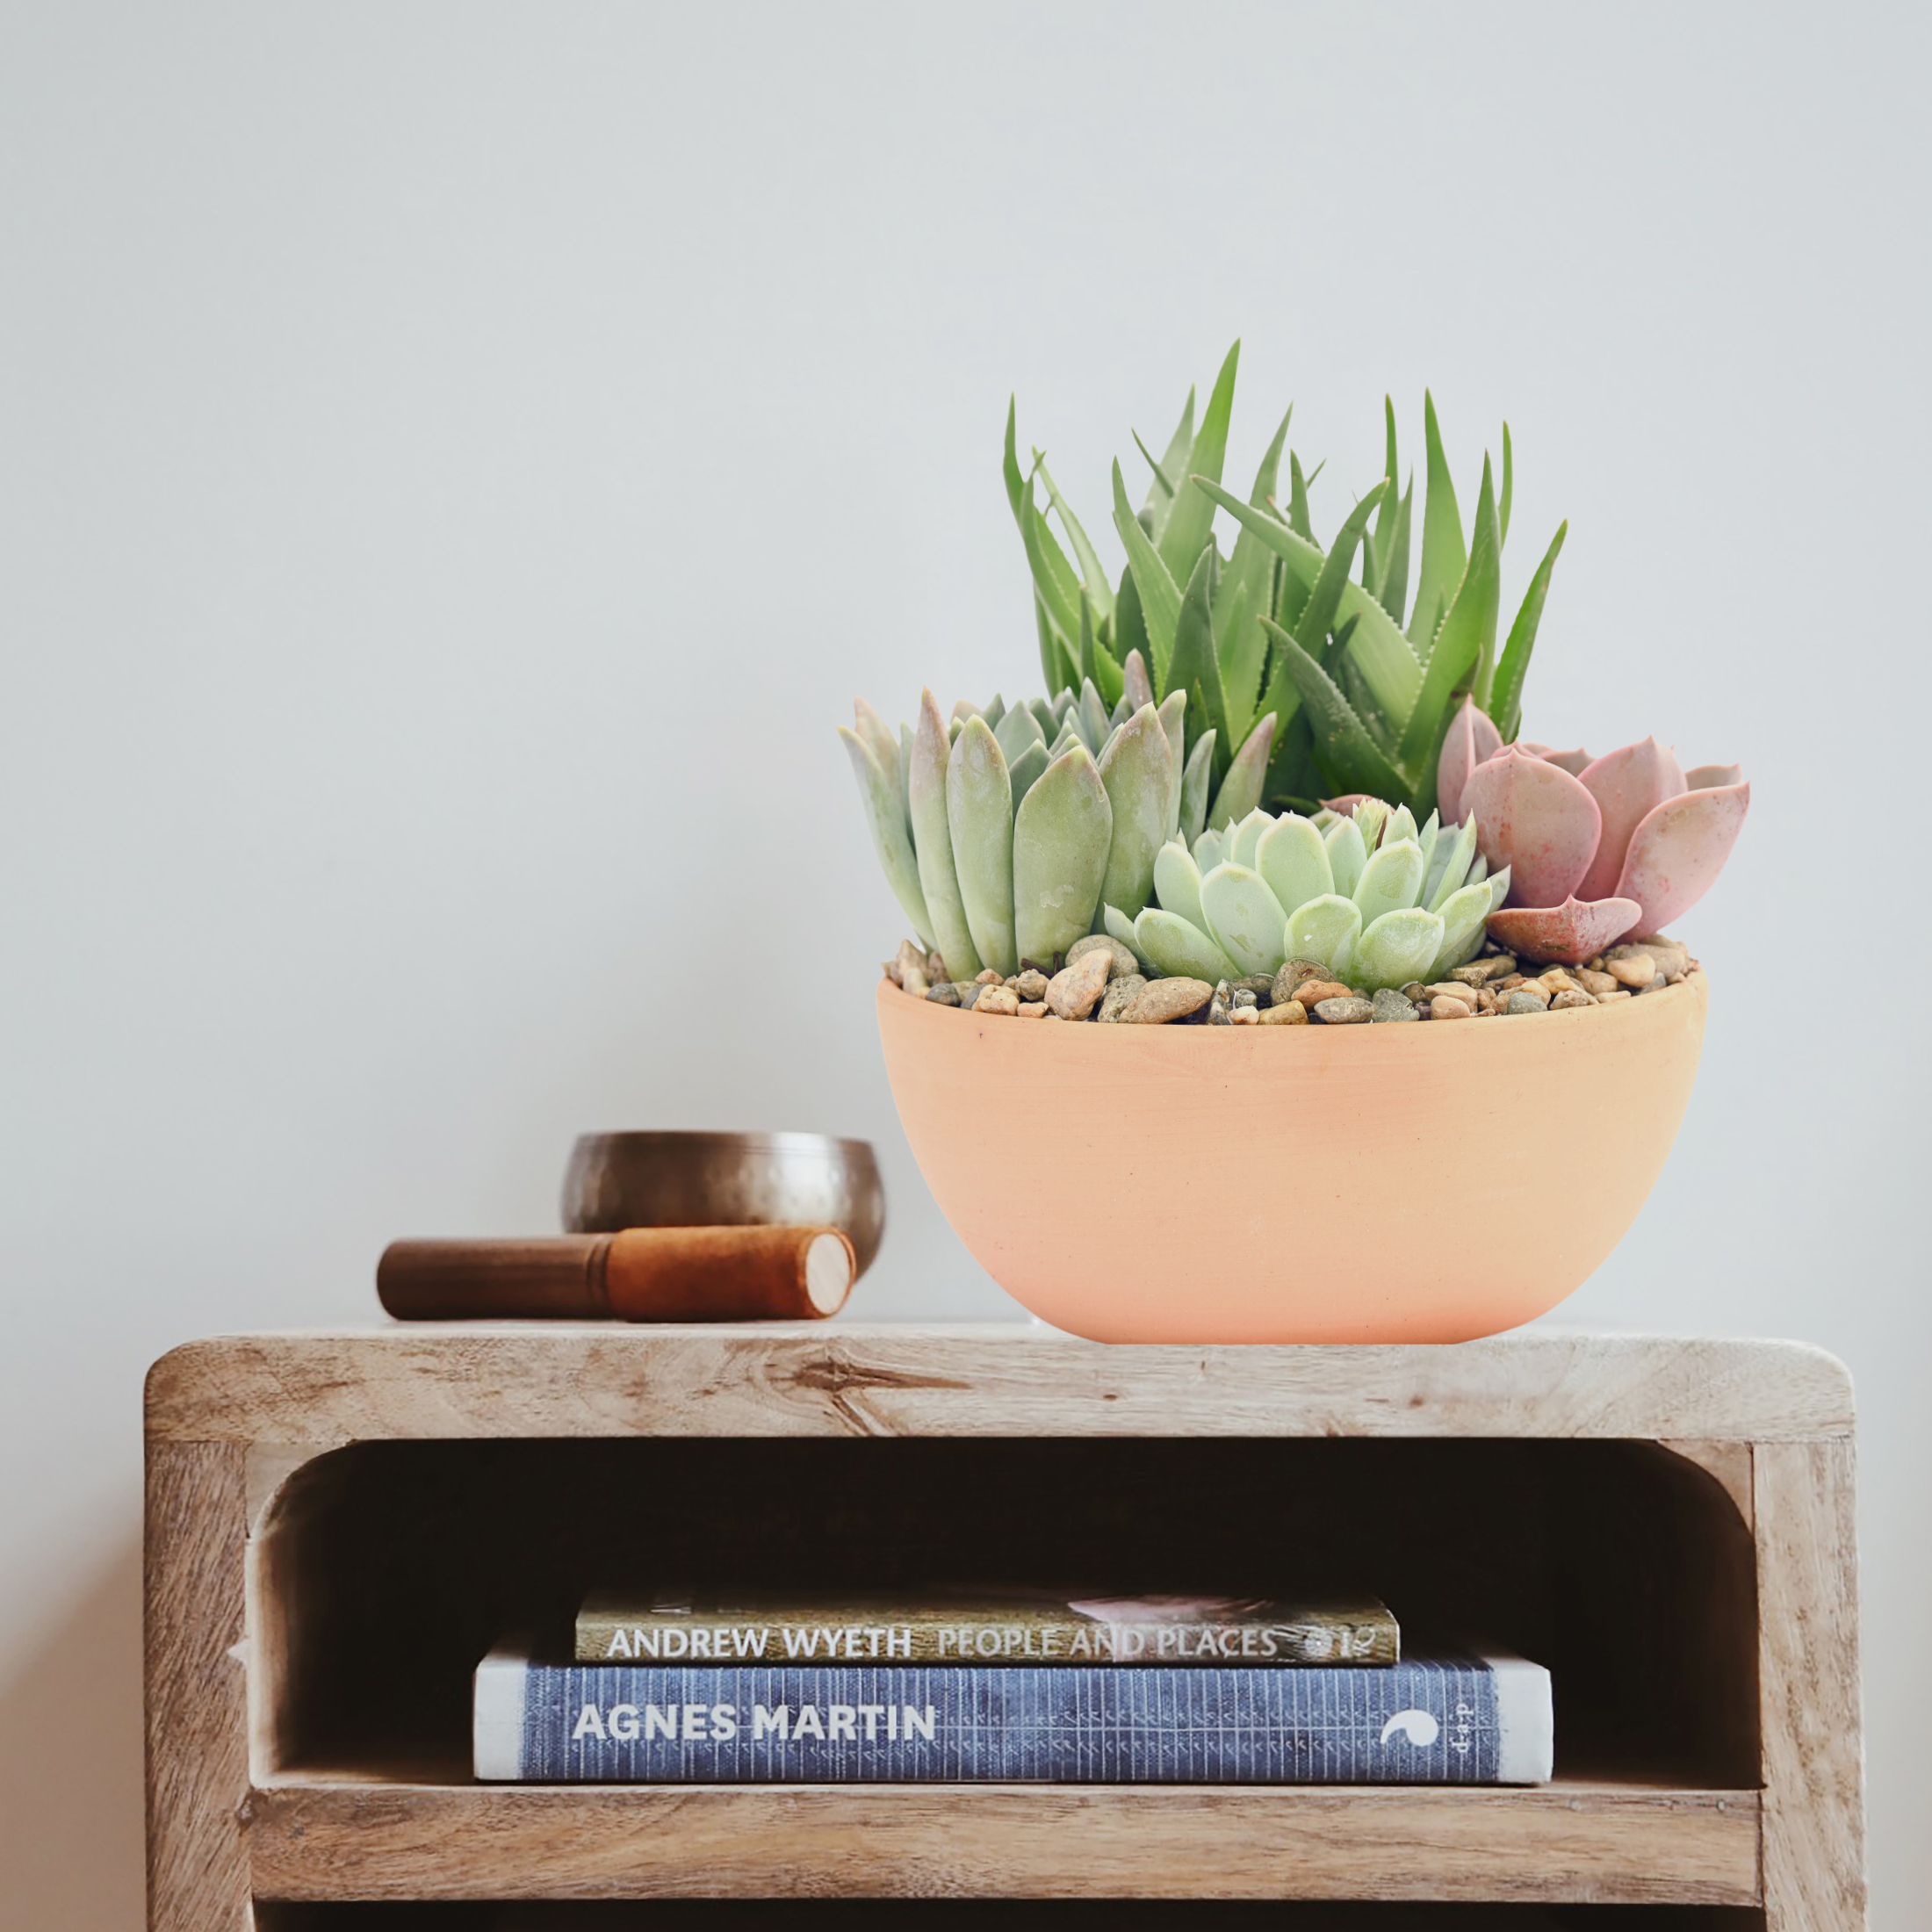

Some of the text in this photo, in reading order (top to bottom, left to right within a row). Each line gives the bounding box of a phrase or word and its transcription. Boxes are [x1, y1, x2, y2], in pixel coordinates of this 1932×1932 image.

[607, 1628, 1278, 1658] ANDREW WYETH PEOPLE AND PLACES
[573, 1704, 935, 1741] AGNES MARTIN
